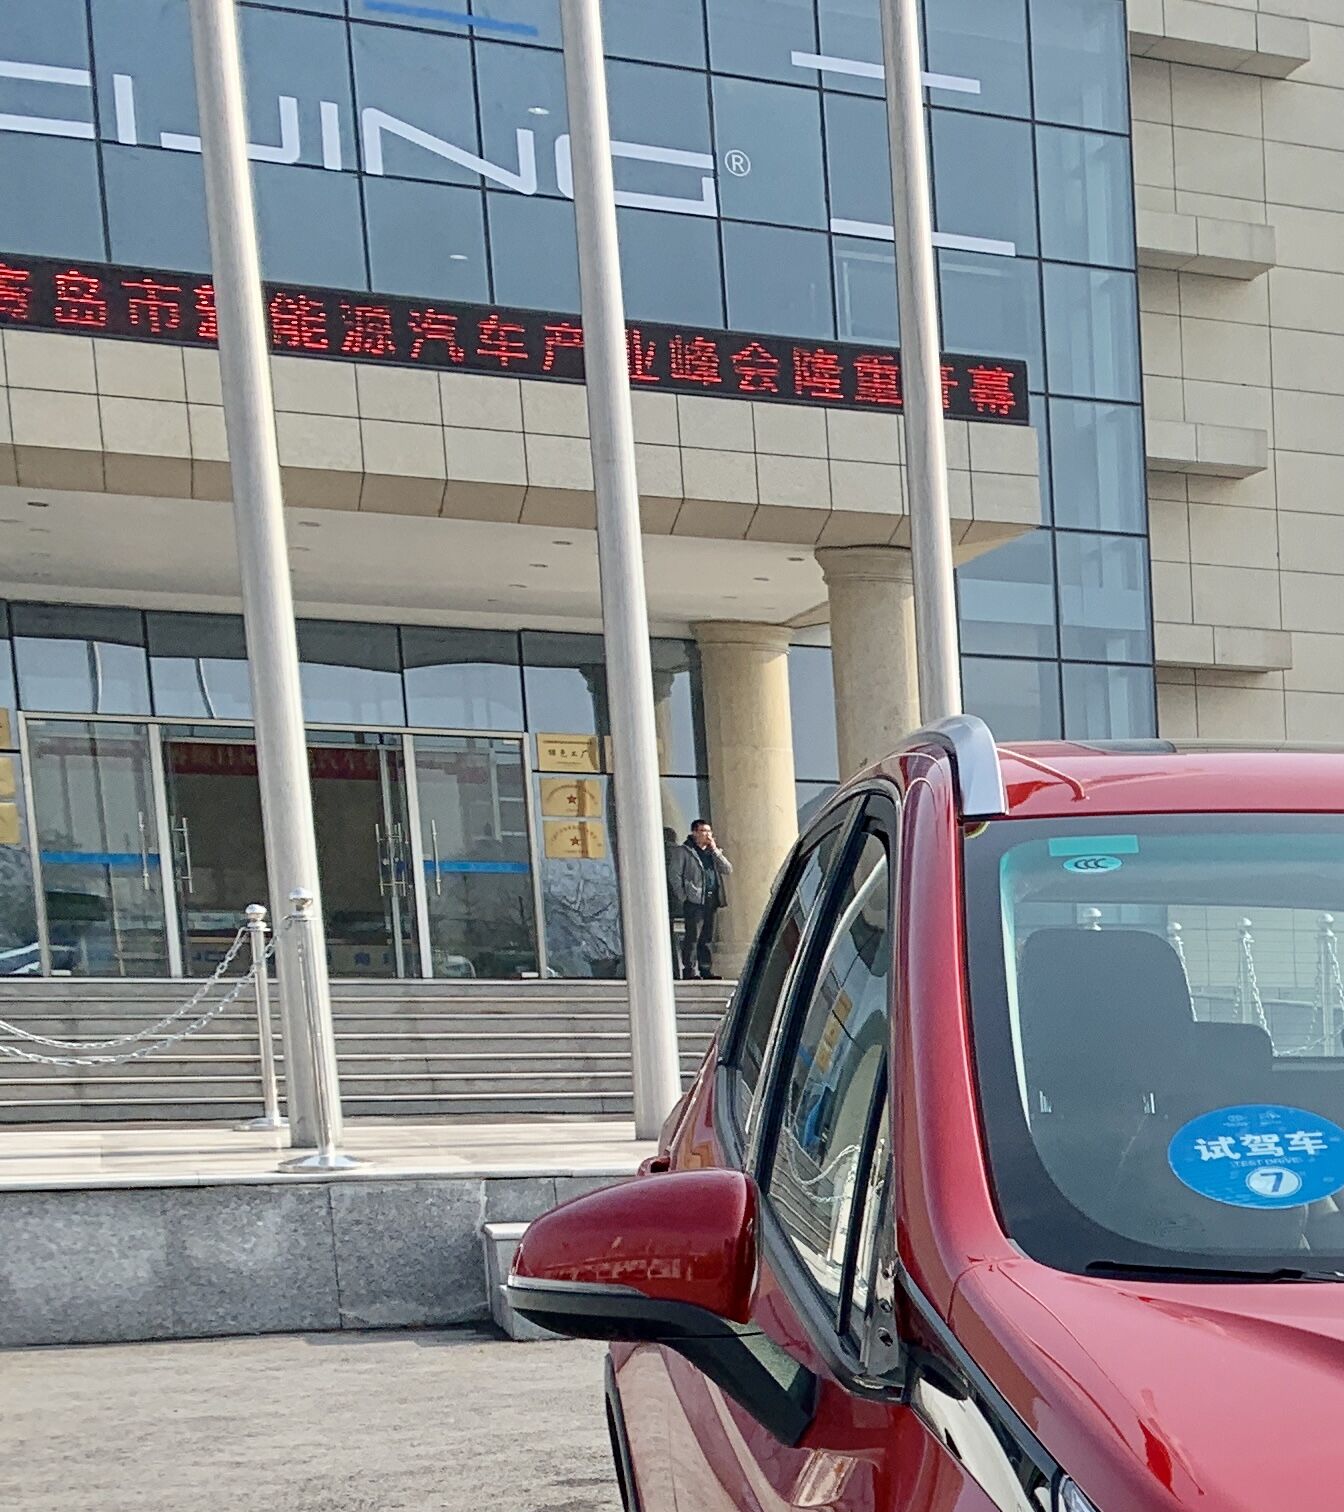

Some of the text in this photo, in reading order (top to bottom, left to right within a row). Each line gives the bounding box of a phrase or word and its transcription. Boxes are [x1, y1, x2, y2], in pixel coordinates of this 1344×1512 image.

[1193, 1129, 1329, 1162] 试驾车
[1259, 1171, 1285, 1193] 7
